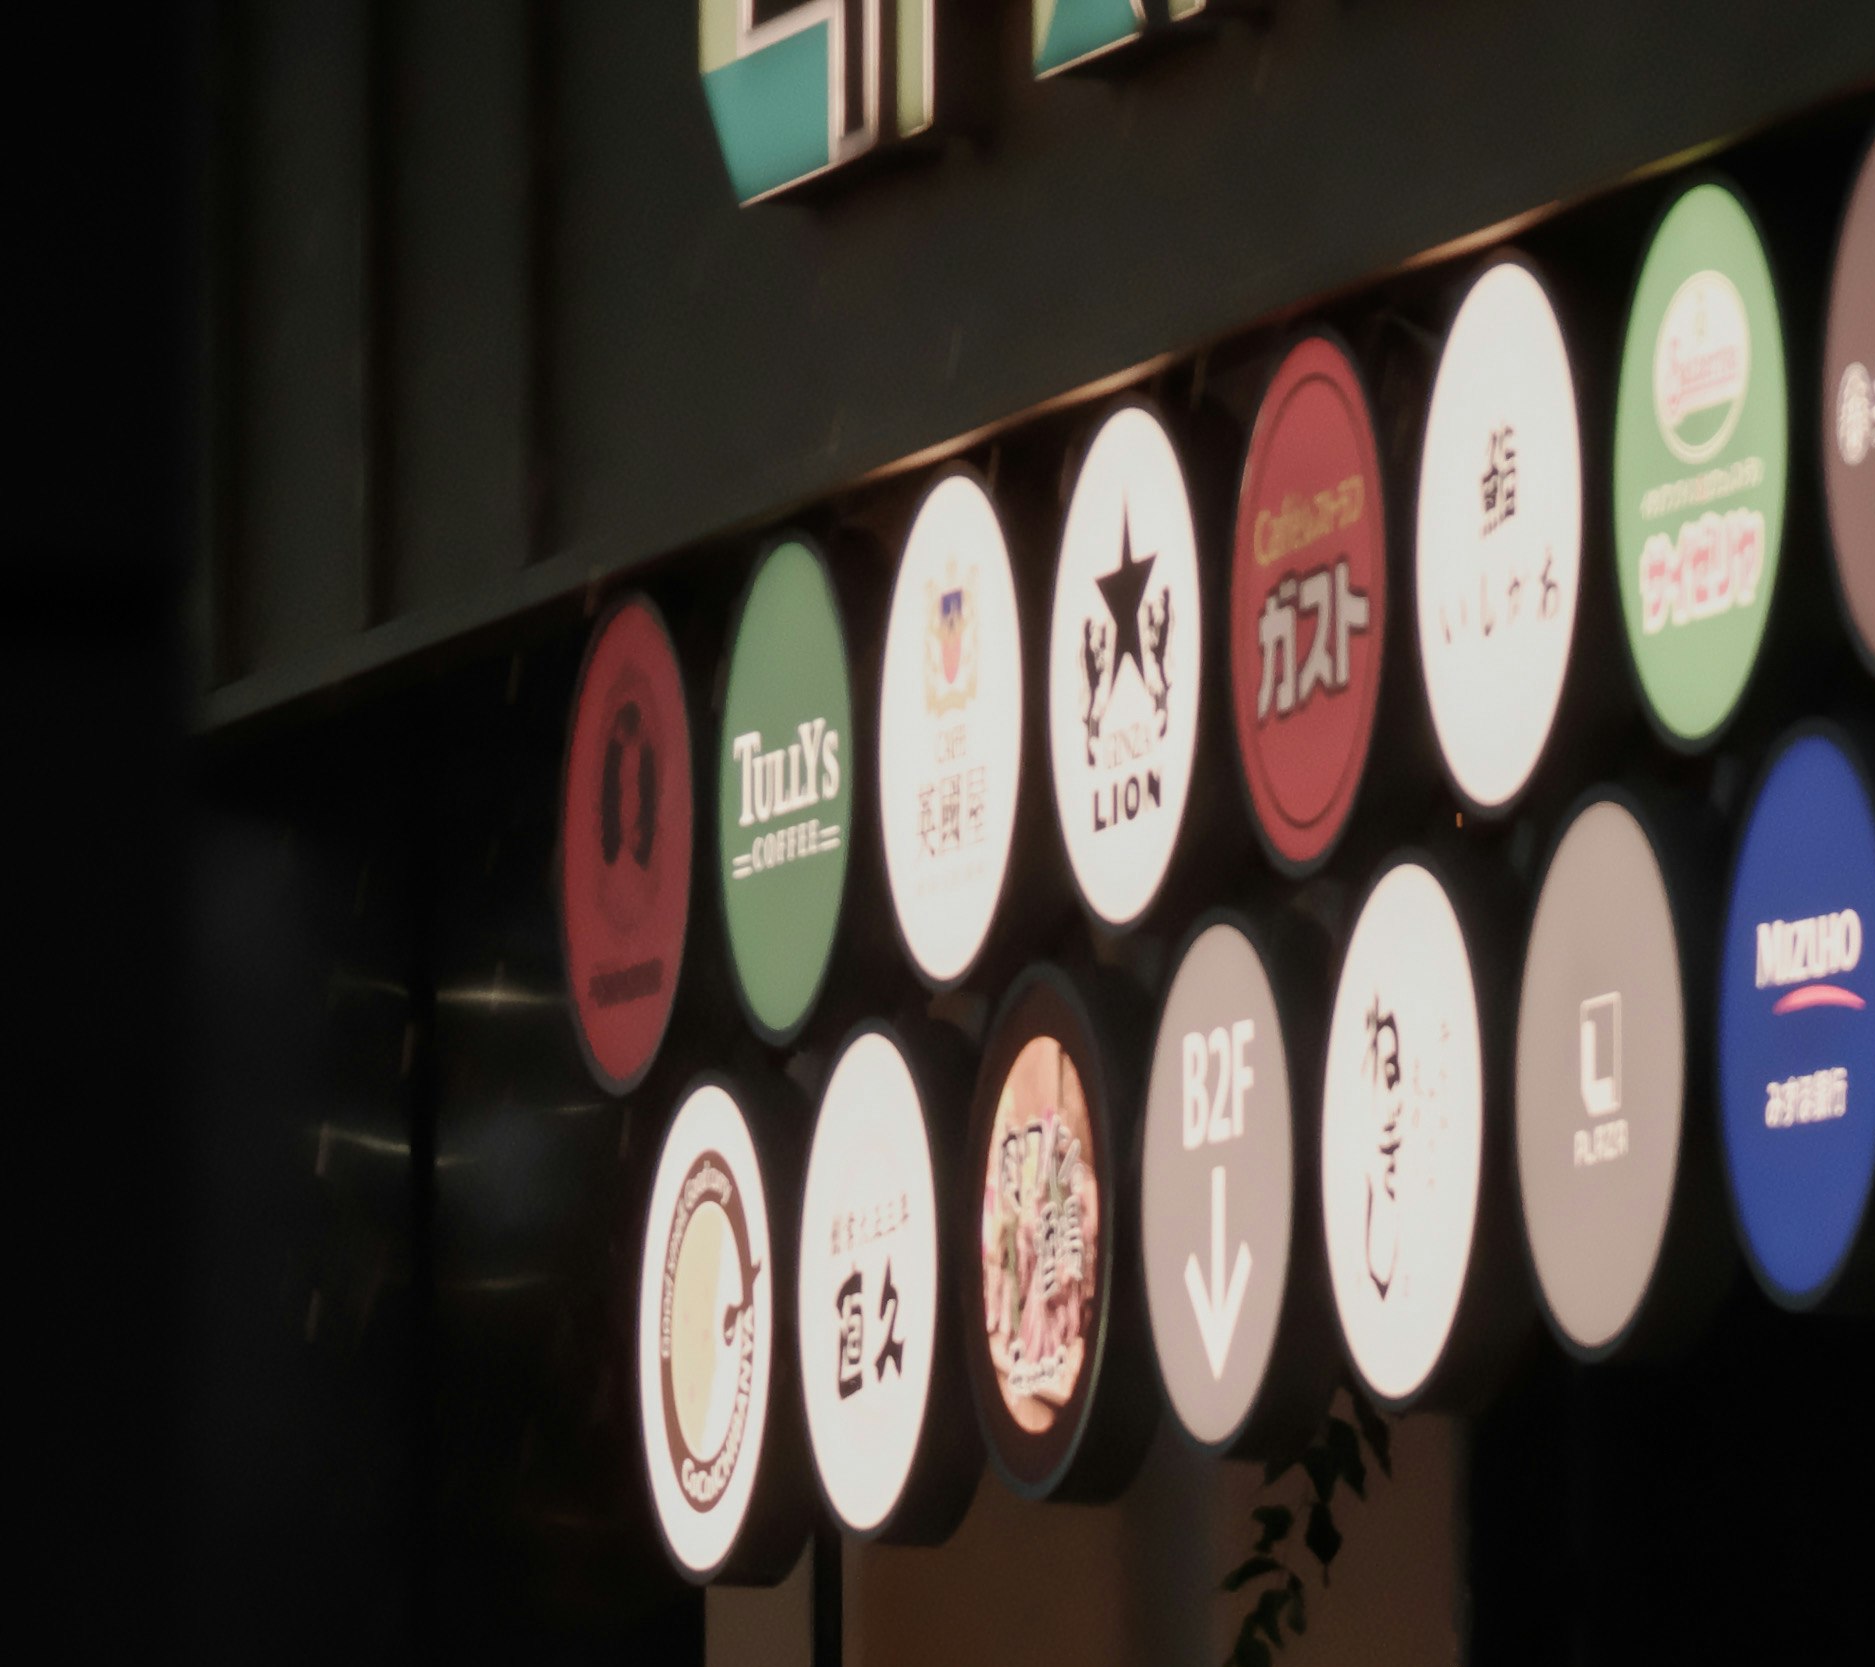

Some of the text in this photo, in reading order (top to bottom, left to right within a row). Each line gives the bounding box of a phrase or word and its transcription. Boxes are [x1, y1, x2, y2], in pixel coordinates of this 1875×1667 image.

[1639, 506, 1767, 634] サイゼリヤ
[1256, 561, 1370, 720] ガスト
[752, 818, 820, 872] COFFEE
[1092, 768, 1162, 832] LION
[1755, 908, 1862, 989] MIZUHO
[1182, 1019, 1255, 1149] B2F
[1765, 1067, 1848, 1128] みずほ銀行
[1360, 992, 1404, 1301] ねぎし
[1574, 1118, 1629, 1167] PLAZA
[835, 1252, 905, 1401] 直久
